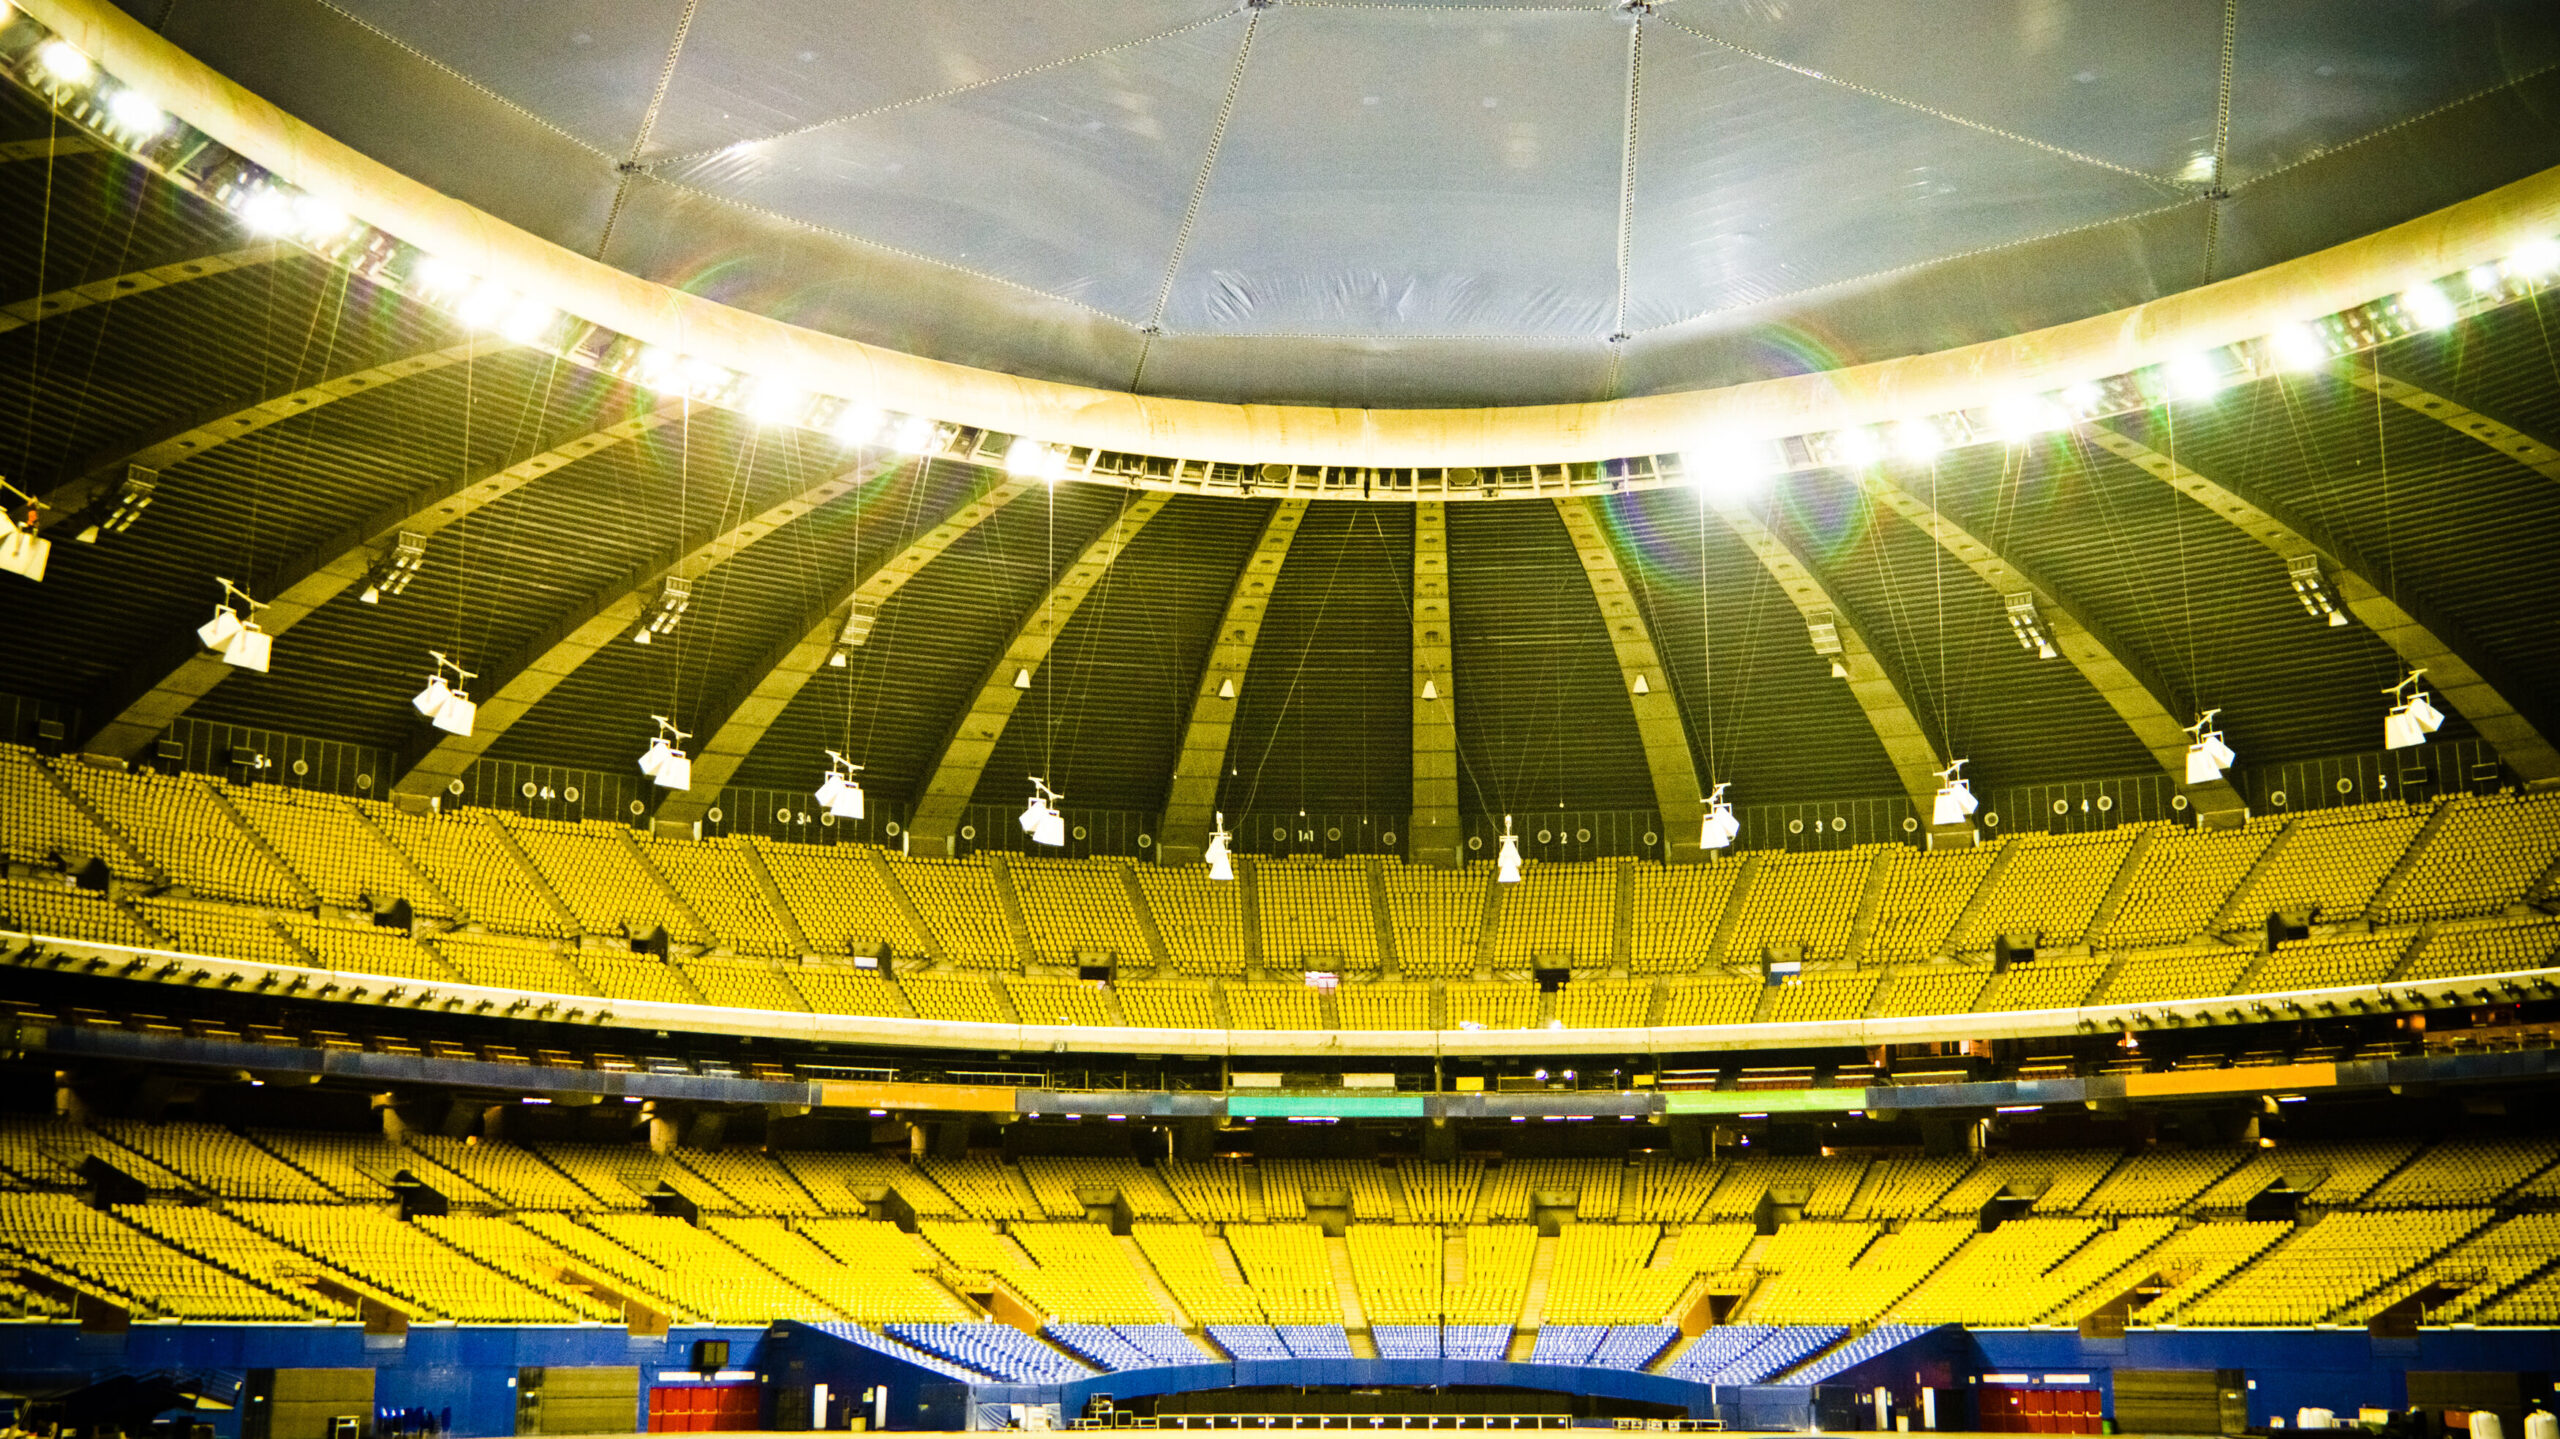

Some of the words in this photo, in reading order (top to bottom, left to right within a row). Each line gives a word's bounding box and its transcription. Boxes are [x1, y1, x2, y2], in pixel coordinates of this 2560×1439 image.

[2379, 774, 2387, 789] 5
[540, 786, 556, 800] 4A
[2081, 799, 2090, 813] 4
[797, 811, 812, 825] 3A
[1815, 820, 1823, 833] 3
[1560, 831, 1568, 844] 2
